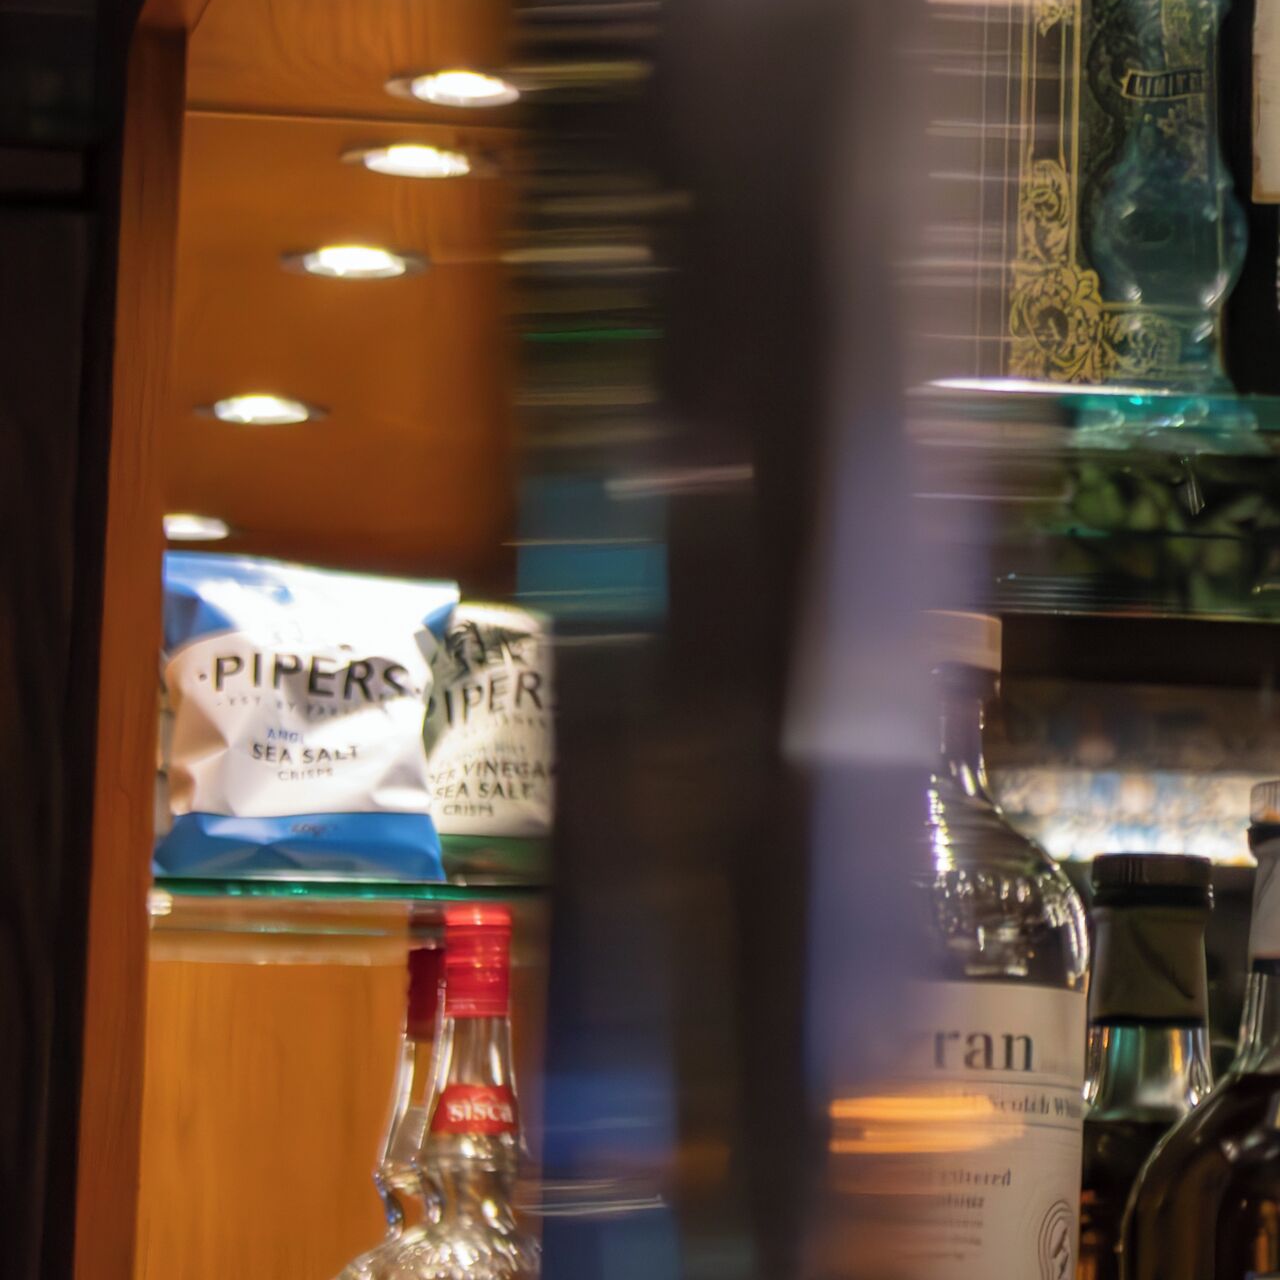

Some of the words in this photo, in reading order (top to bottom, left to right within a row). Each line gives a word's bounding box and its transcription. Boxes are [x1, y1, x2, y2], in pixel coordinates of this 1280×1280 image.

[215, 652, 411, 702] PIPERS
[252, 742, 294, 765] SEA
[303, 744, 359, 765] SALT
[277, 767, 334, 783] CRISPS
[463, 759, 548, 779] VINEGA
[478, 780, 532, 801] SALT
